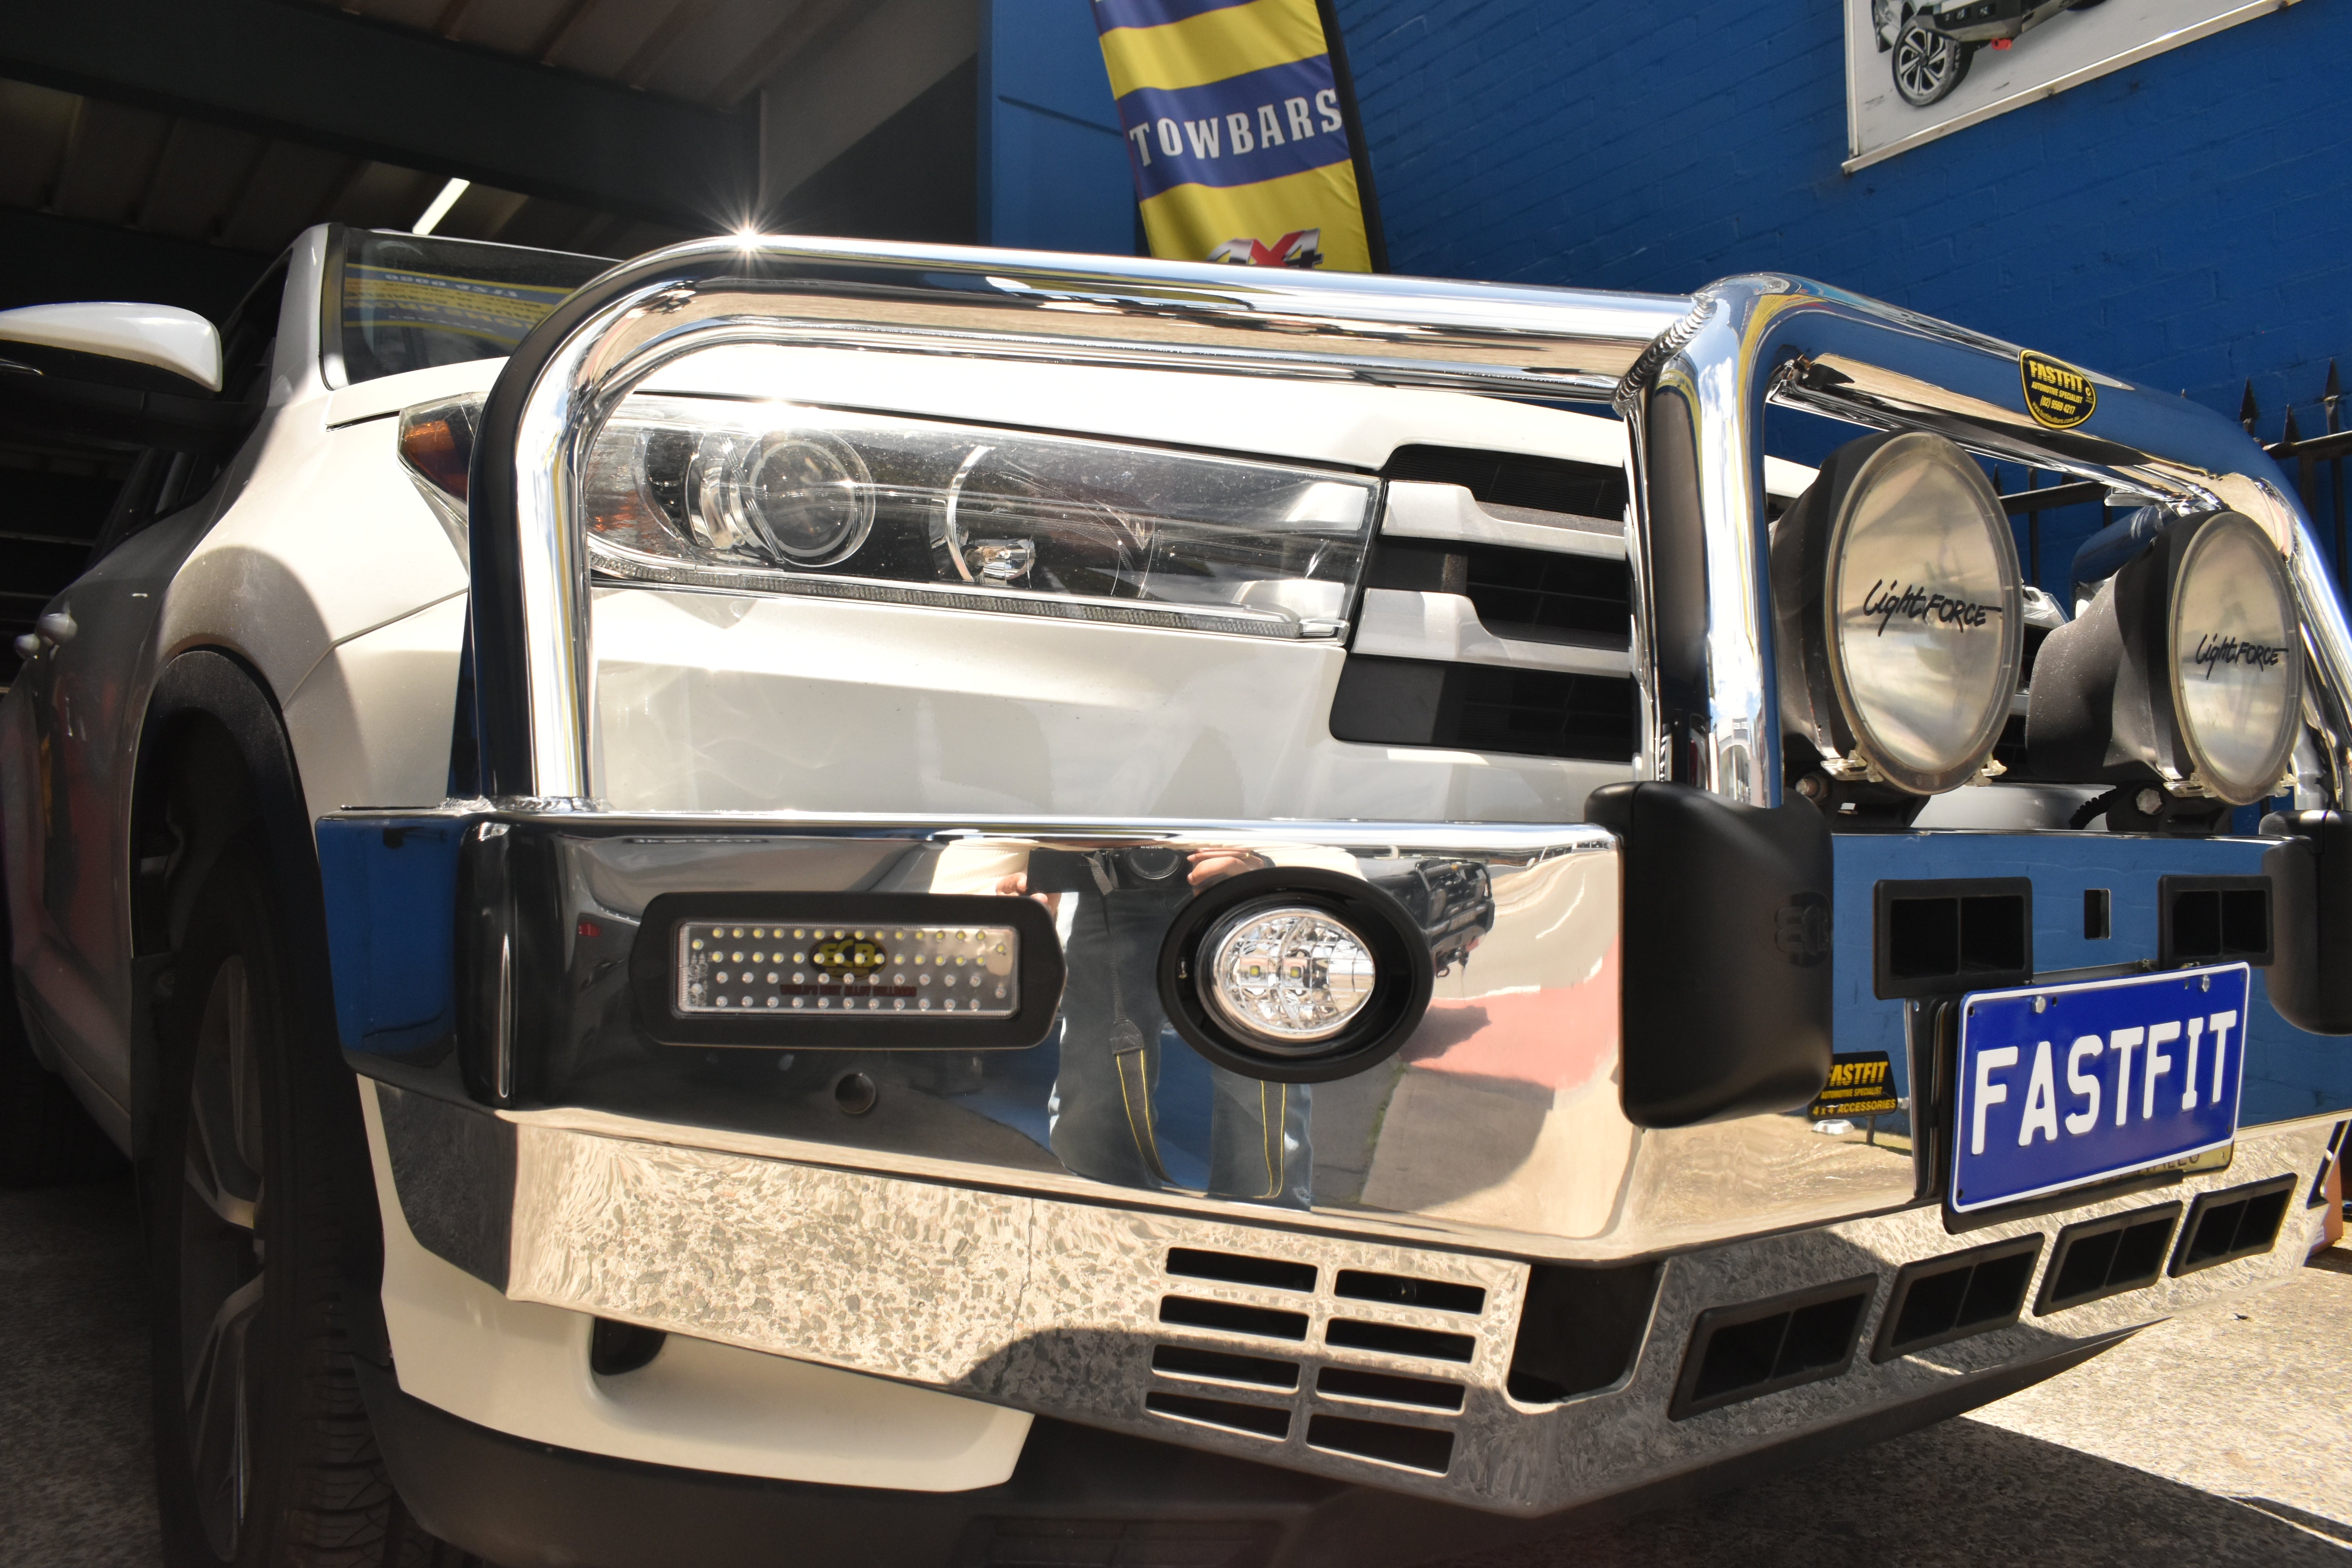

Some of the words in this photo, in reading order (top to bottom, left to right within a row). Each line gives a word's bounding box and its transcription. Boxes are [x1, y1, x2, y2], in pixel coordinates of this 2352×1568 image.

[1129, 89, 1343, 167] TOWBARS
[2029, 360, 2083, 393] FASTFIT
[2031, 381, 2059, 396] AUTOMOTIVE
[2059, 390, 2083, 404] SPECIALIST
[2040, 395, 2051, 408] (02)
[2051, 399, 2063, 411] 9569
[2063, 404, 2076, 415] 4217
[1854, 1086, 1883, 1096] SPECIALIST
[1971, 1010, 2237, 1155] FASTFIT
[1813, 1106, 1819, 1116] 4
[1828, 1106, 1834, 1114] 4
[1837, 1099, 1896, 1113] ACCESSORIES
